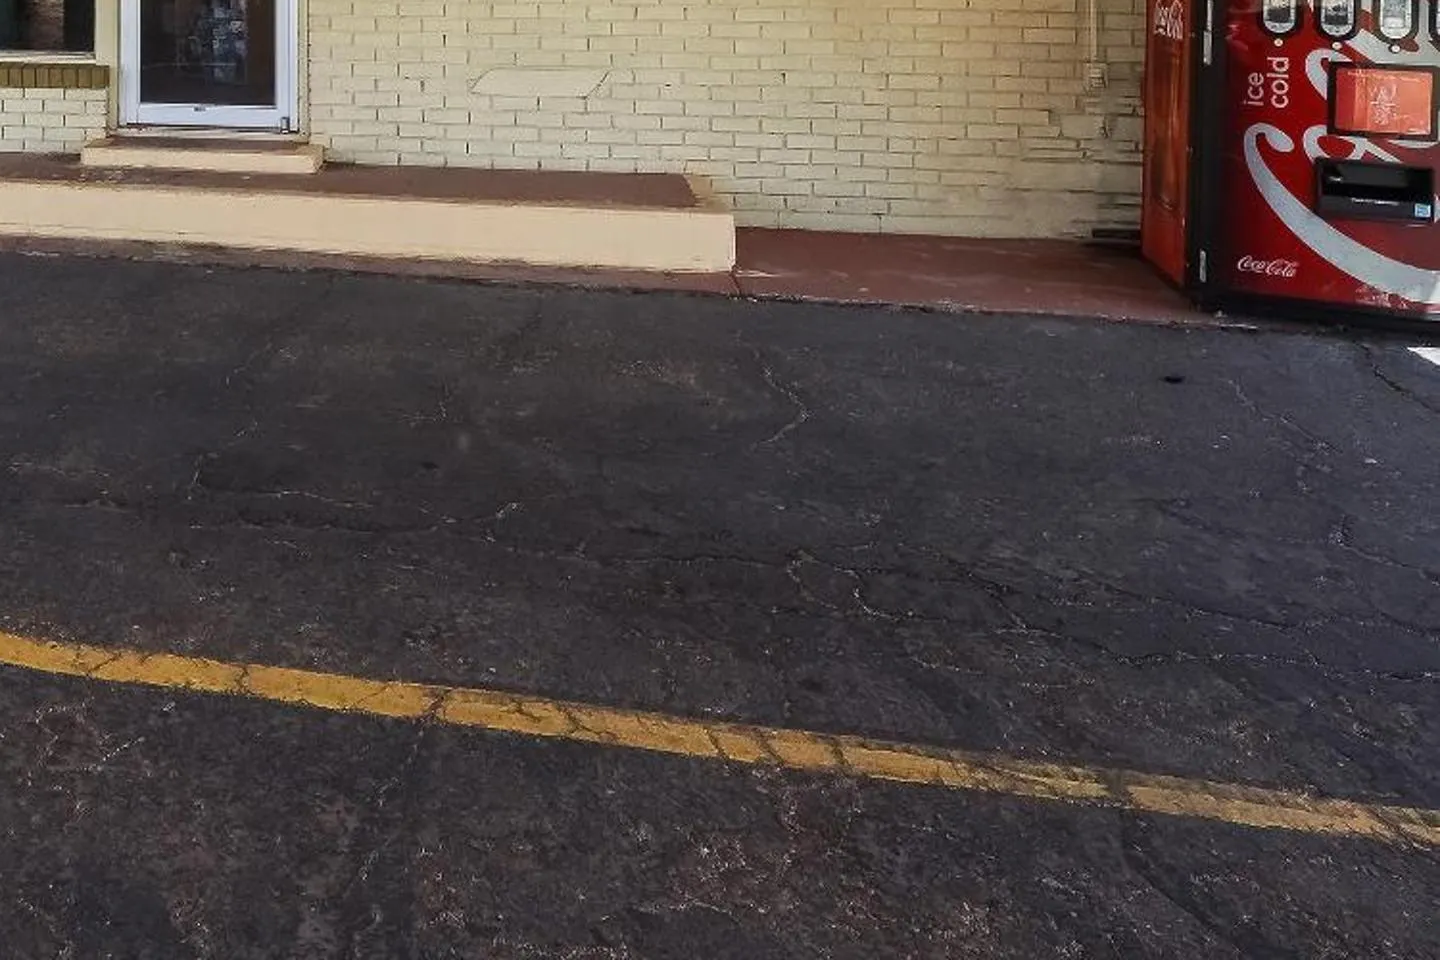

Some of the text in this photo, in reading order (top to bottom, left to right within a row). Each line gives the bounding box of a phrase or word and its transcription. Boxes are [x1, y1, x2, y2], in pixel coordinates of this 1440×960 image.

[1243, 72, 1264, 106] ice
[1266, 56, 1289, 109] cold
[1237, 255, 1300, 278] Coca-Cola
